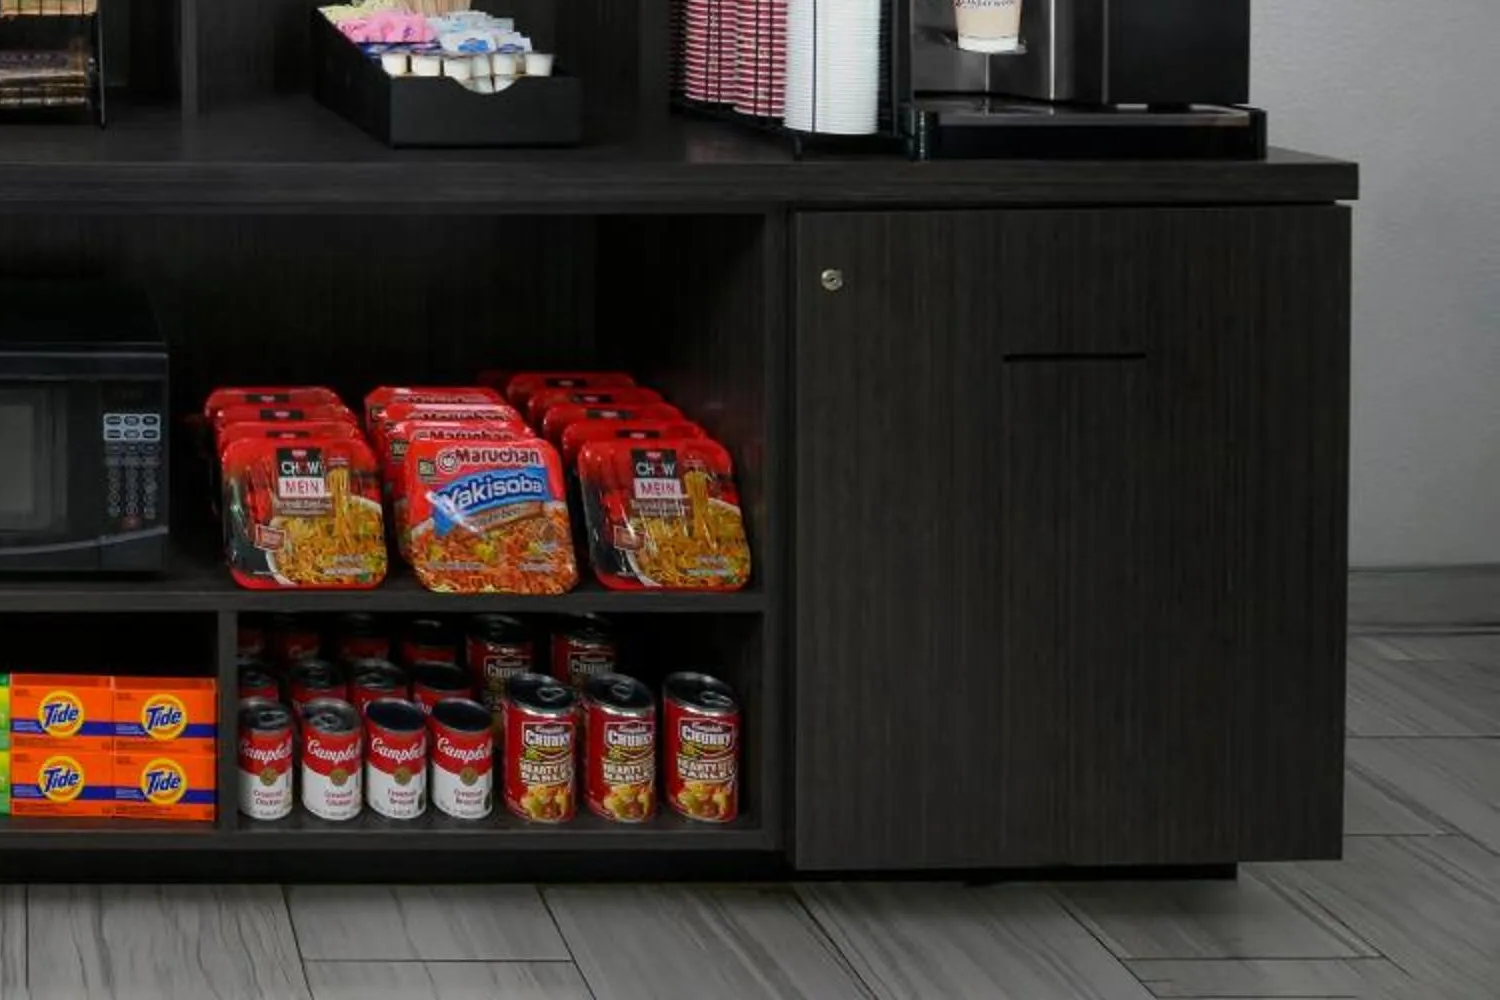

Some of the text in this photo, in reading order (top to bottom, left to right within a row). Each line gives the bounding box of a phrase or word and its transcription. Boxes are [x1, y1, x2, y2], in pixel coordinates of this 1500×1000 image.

[456, 449, 540, 465] Maruchan
[284, 481, 320, 494] MEIN
[443, 475, 544, 511] Yakisoba
[44, 703, 80, 729] Tide
[146, 706, 182, 733] Tide
[44, 766, 80, 793] Tide
[146, 770, 182, 796] Tide
